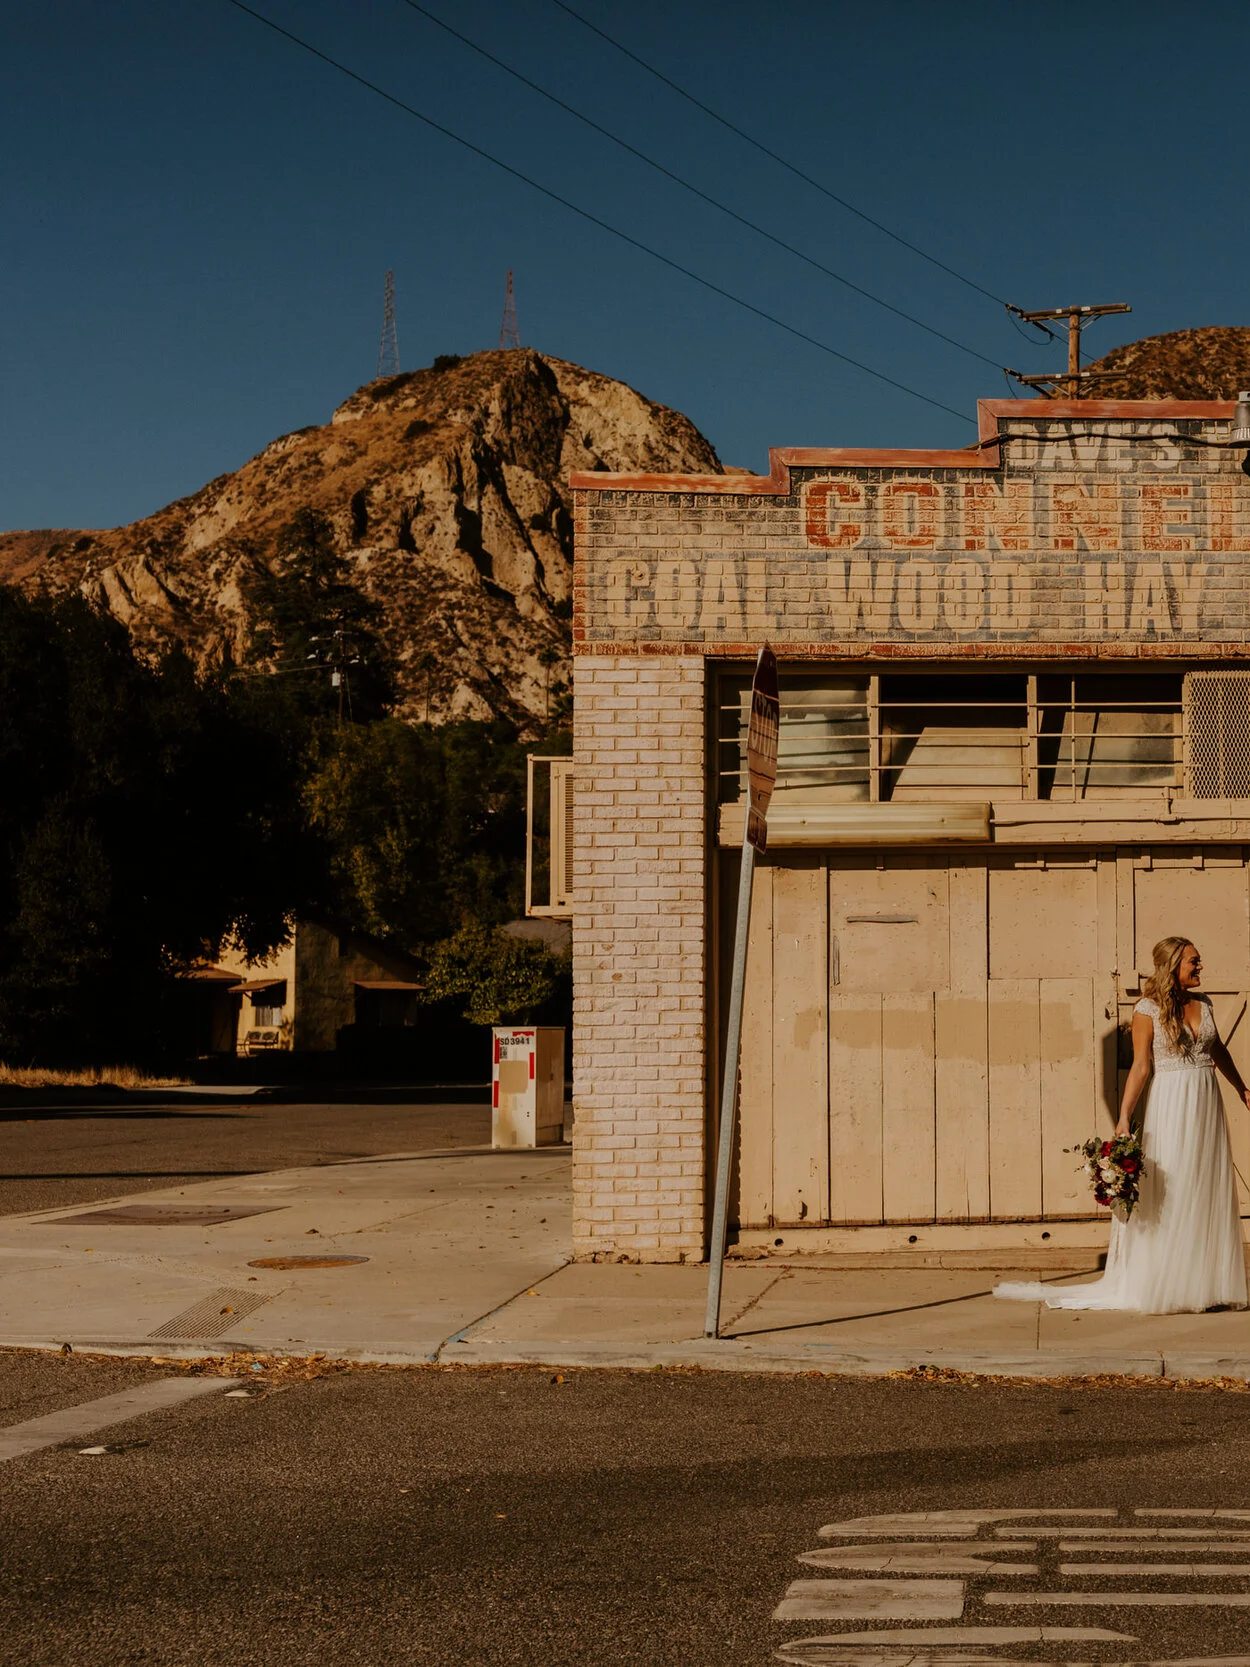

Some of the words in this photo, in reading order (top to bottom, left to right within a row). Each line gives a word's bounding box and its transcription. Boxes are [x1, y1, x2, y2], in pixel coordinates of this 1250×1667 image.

[1006, 423, 1181, 470] DAVE'S
[606, 557, 780, 630] COAL
[827, 558, 1034, 633] WOOD
[1084, 560, 1210, 632] HAY
[752, 695, 777, 767] STOP
